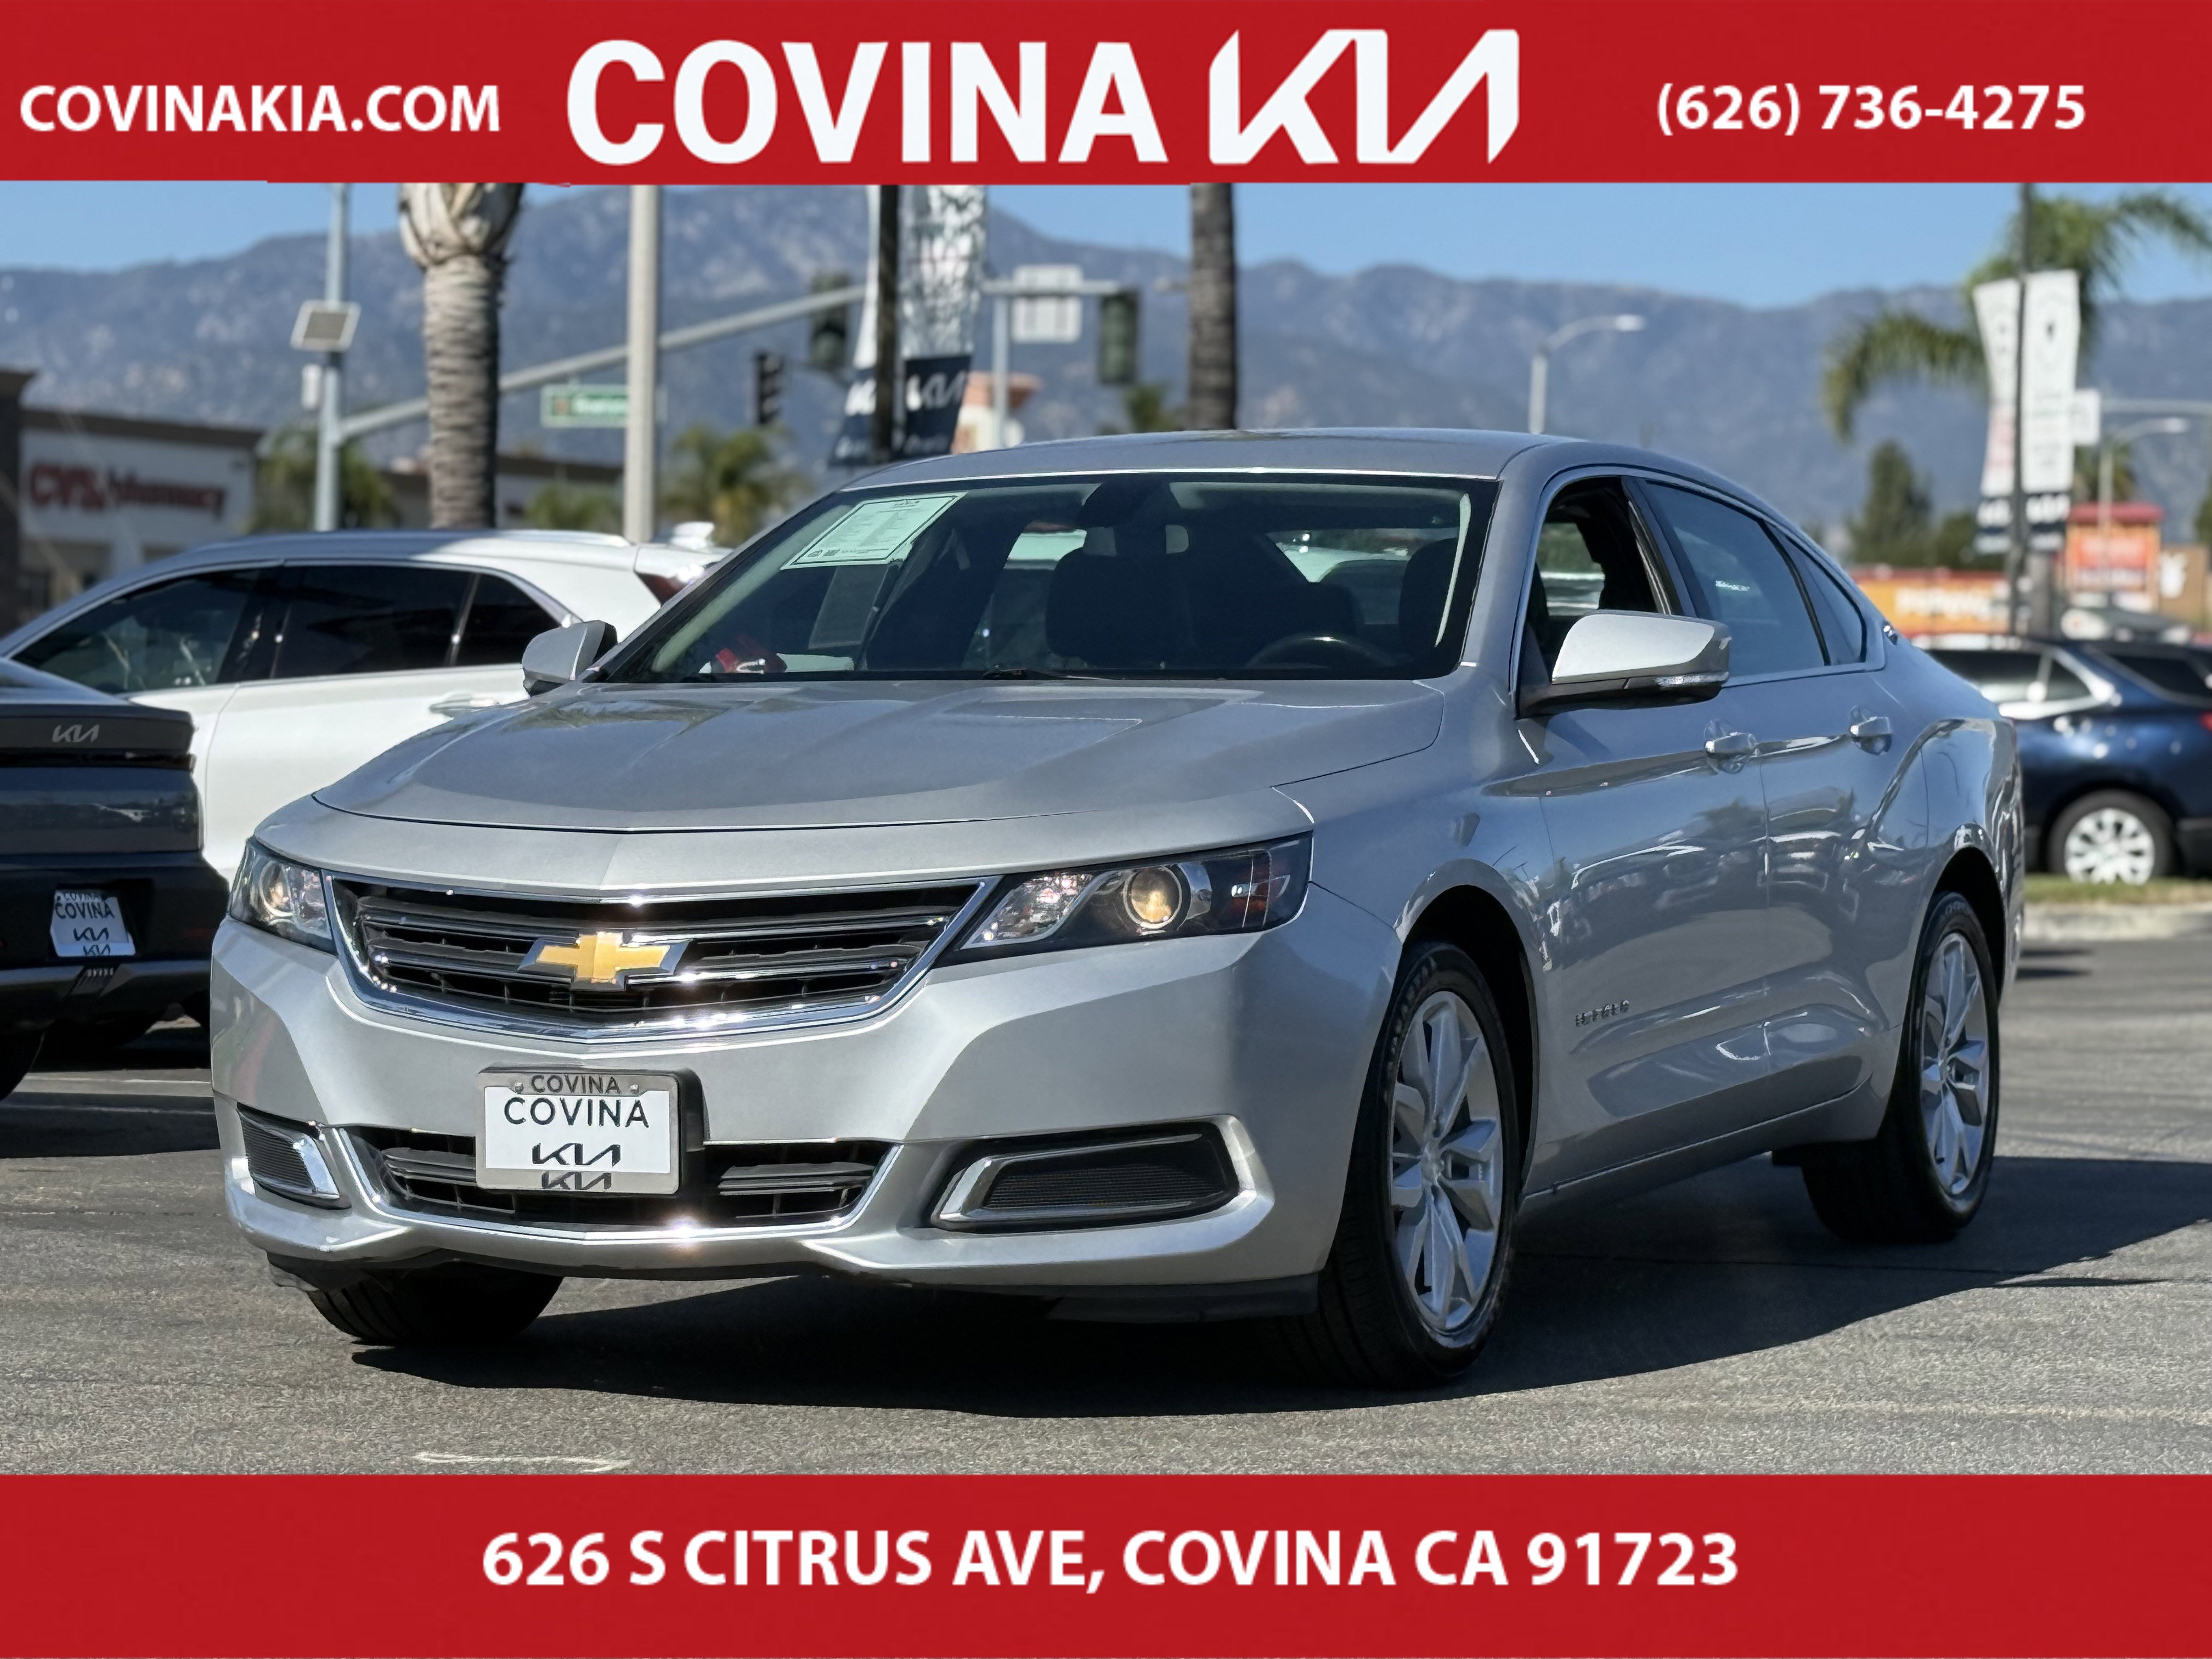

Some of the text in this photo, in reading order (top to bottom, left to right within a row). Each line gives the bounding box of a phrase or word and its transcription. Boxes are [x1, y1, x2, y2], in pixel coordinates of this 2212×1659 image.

[52, 724, 99, 743] KIA
[55, 902, 115, 919] COVINA
[531, 1074, 622, 1094] COVINA
[504, 1097, 650, 1128] COVINA
[532, 1142, 621, 1167] KIA
[541, 1170, 612, 1190] KIA
